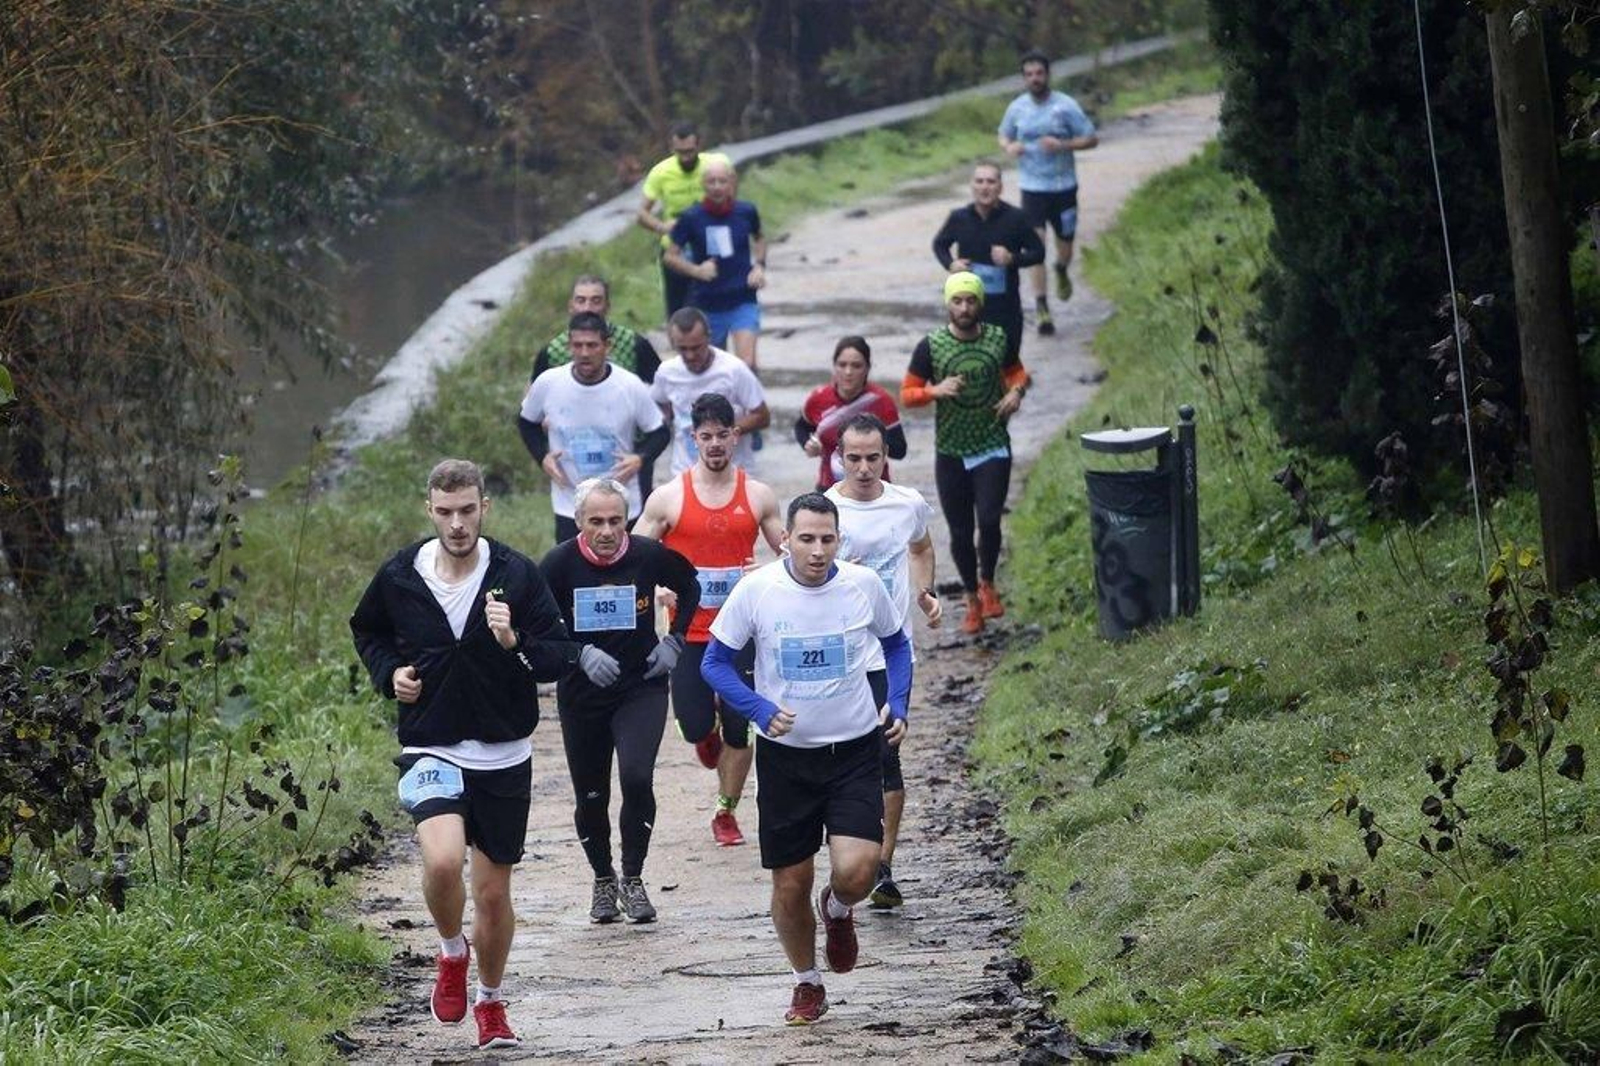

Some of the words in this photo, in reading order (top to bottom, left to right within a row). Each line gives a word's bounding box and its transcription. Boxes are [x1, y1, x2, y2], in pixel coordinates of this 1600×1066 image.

[706, 581, 727, 593] 280
[594, 600, 617, 614] 435
[802, 649, 826, 665] 221
[417, 769, 440, 785] 372
